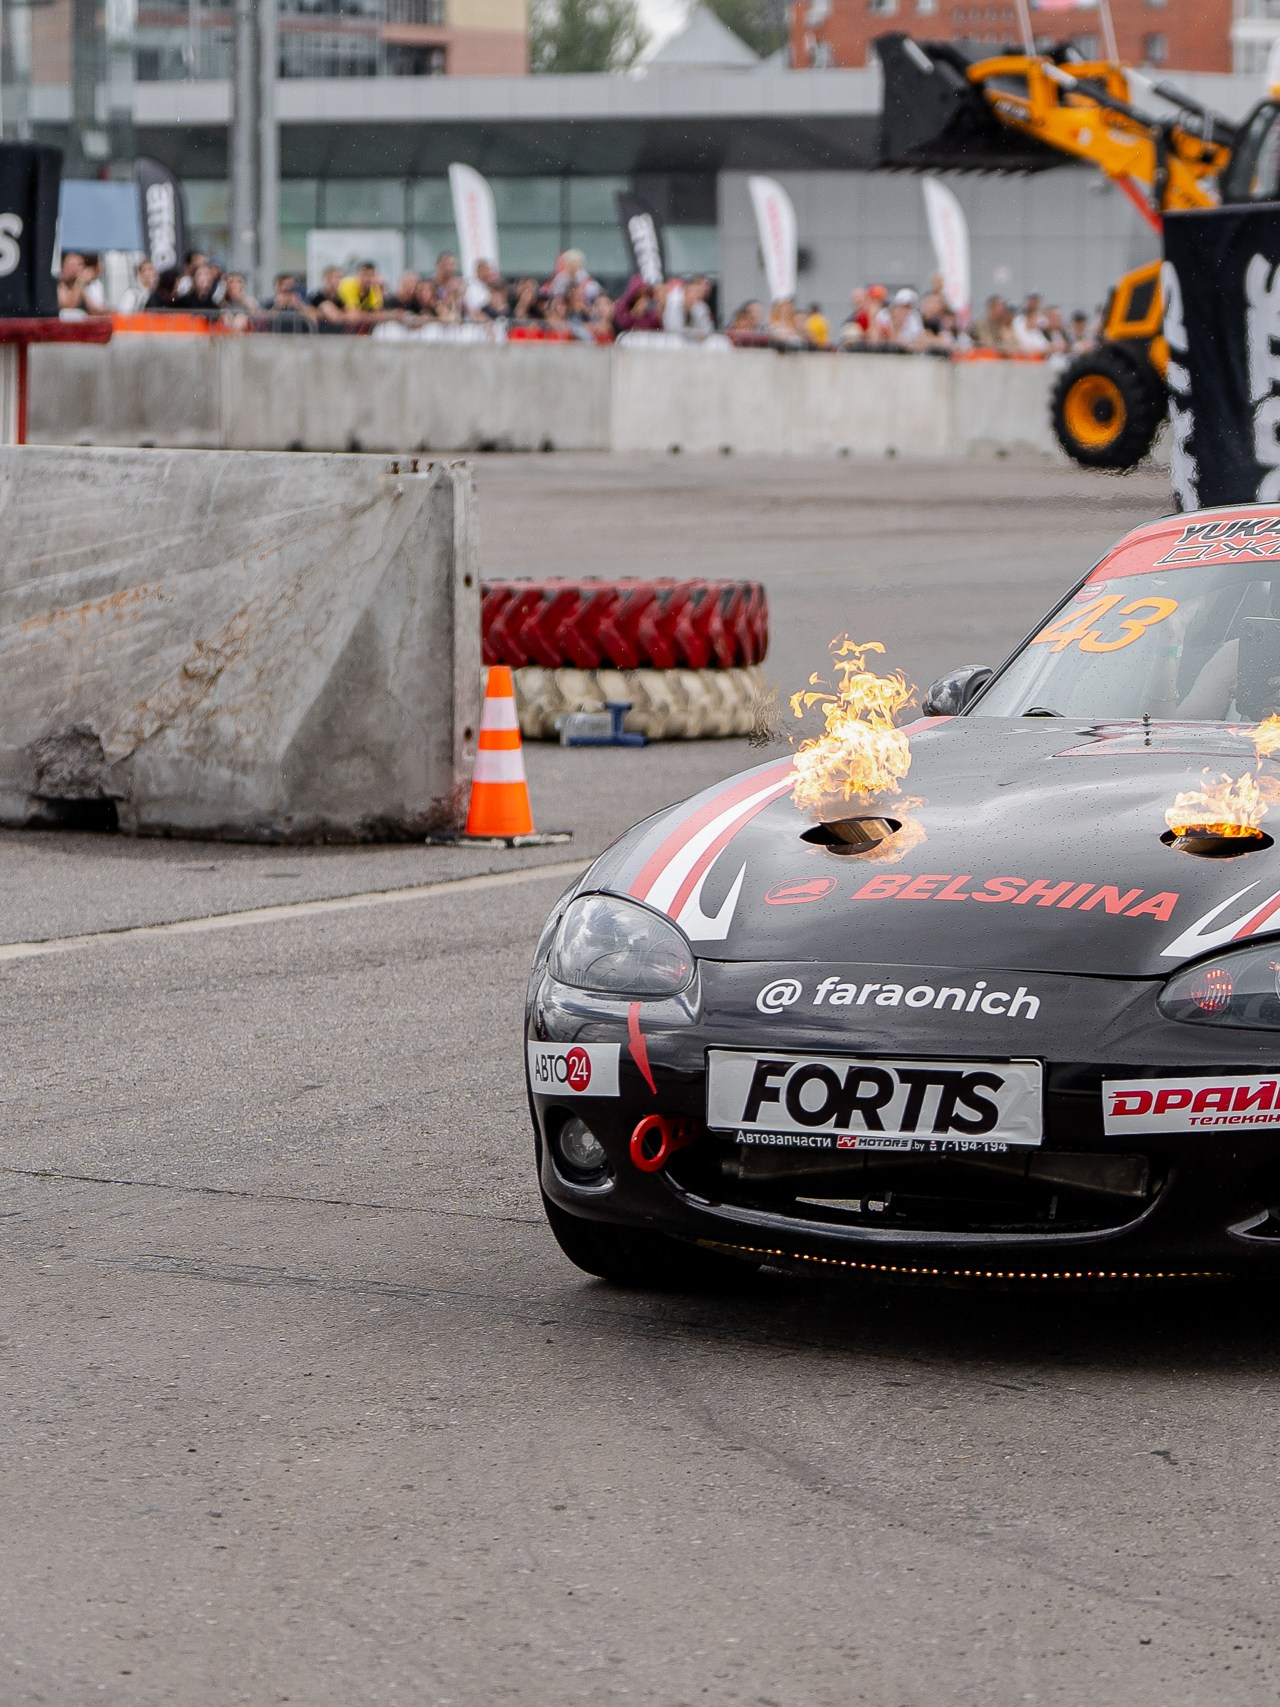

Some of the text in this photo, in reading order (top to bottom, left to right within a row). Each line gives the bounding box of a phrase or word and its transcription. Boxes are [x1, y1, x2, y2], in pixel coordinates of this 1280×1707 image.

[1029, 594, 1179, 653] 43
[851, 873, 1180, 922] BELSHINA
[812, 976, 1041, 1020] faraonich
[741, 1059, 1006, 1135] FORTIS
[736, 1130, 832, 1147] Автозапчасти
